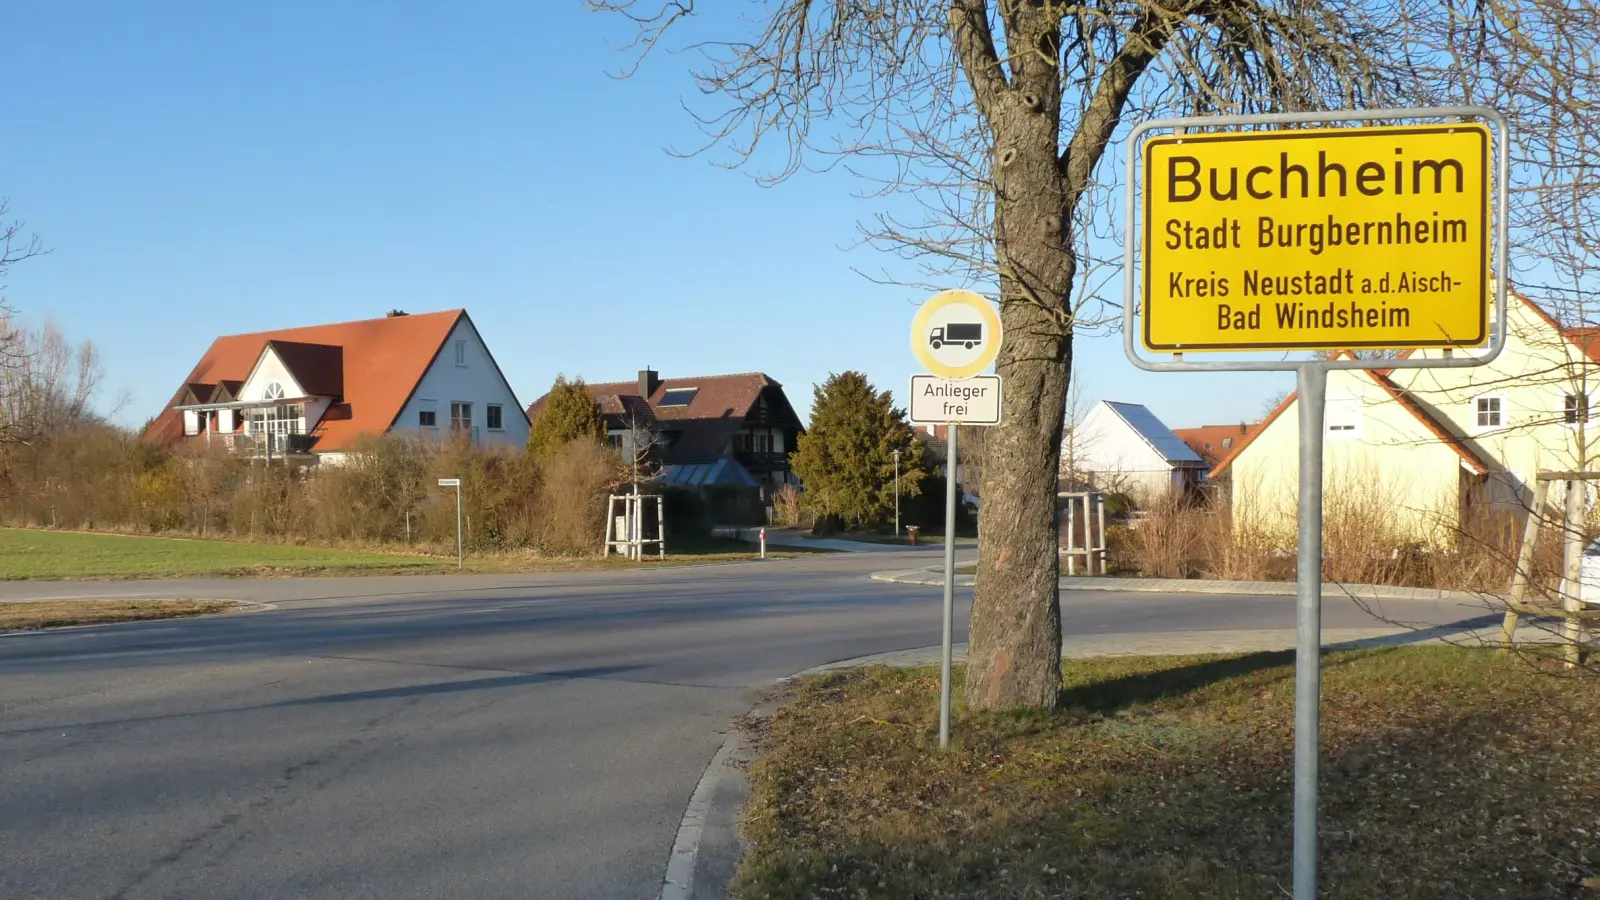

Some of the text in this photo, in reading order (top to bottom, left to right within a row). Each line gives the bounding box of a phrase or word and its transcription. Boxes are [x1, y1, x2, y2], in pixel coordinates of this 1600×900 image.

[1169, 148, 1463, 202] Buchheim
[1166, 212, 1466, 255] Stadt Burgbernheim
[1170, 271, 1229, 297] Kreis
[1244, 268, 1353, 296] Neustadt
[1217, 301, 1409, 330] Bad Windsheim
[924, 384, 987, 400] Anlieger
[943, 402, 968, 415] frei
